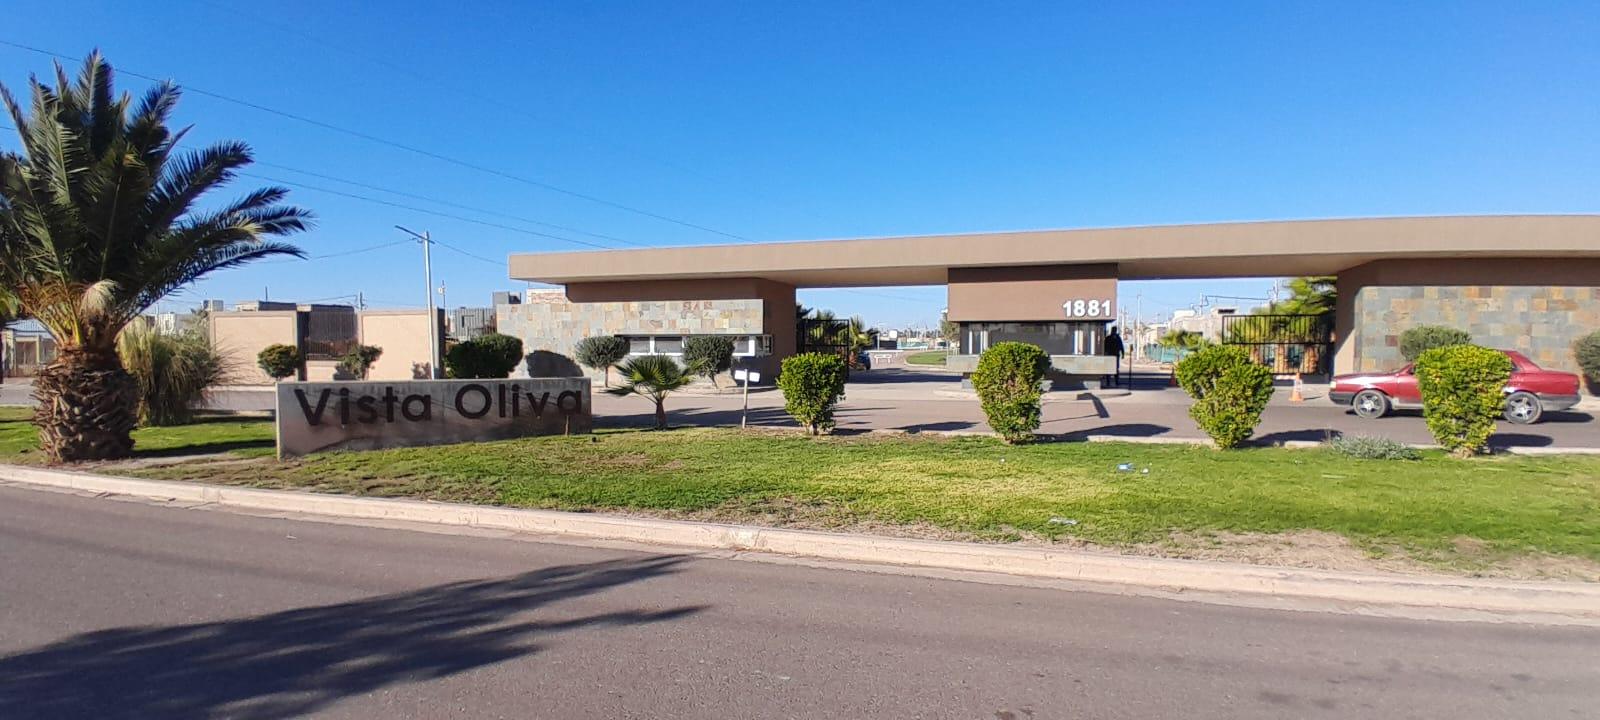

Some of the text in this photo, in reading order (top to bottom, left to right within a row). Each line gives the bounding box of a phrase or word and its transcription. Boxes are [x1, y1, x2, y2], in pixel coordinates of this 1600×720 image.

[1062, 299, 1111, 317] 1881
[294, 383, 582, 426] Vista Oliva
